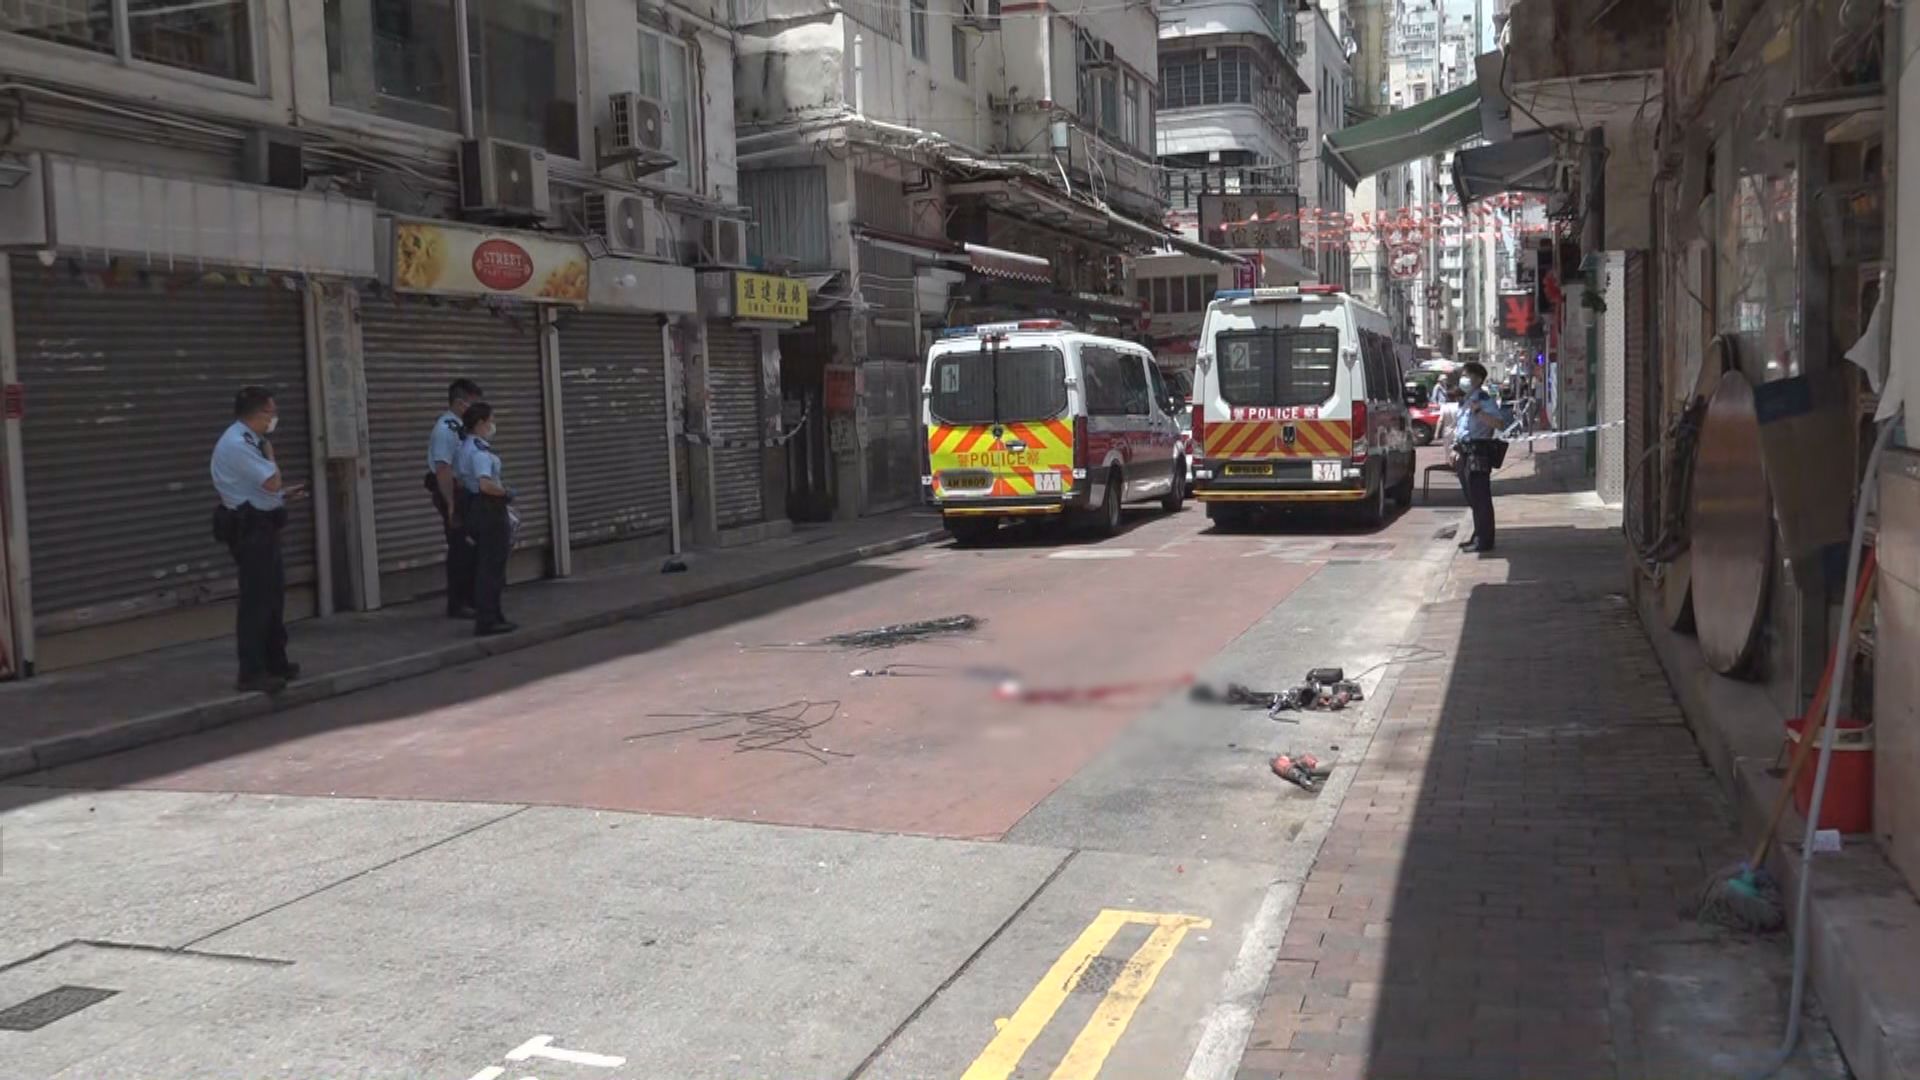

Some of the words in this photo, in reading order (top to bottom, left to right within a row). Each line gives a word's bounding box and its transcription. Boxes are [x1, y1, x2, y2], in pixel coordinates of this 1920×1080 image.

[483, 251, 521, 266] STREET
[1248, 406, 1299, 419] POLICE
[970, 452, 1025, 467] POLICE
